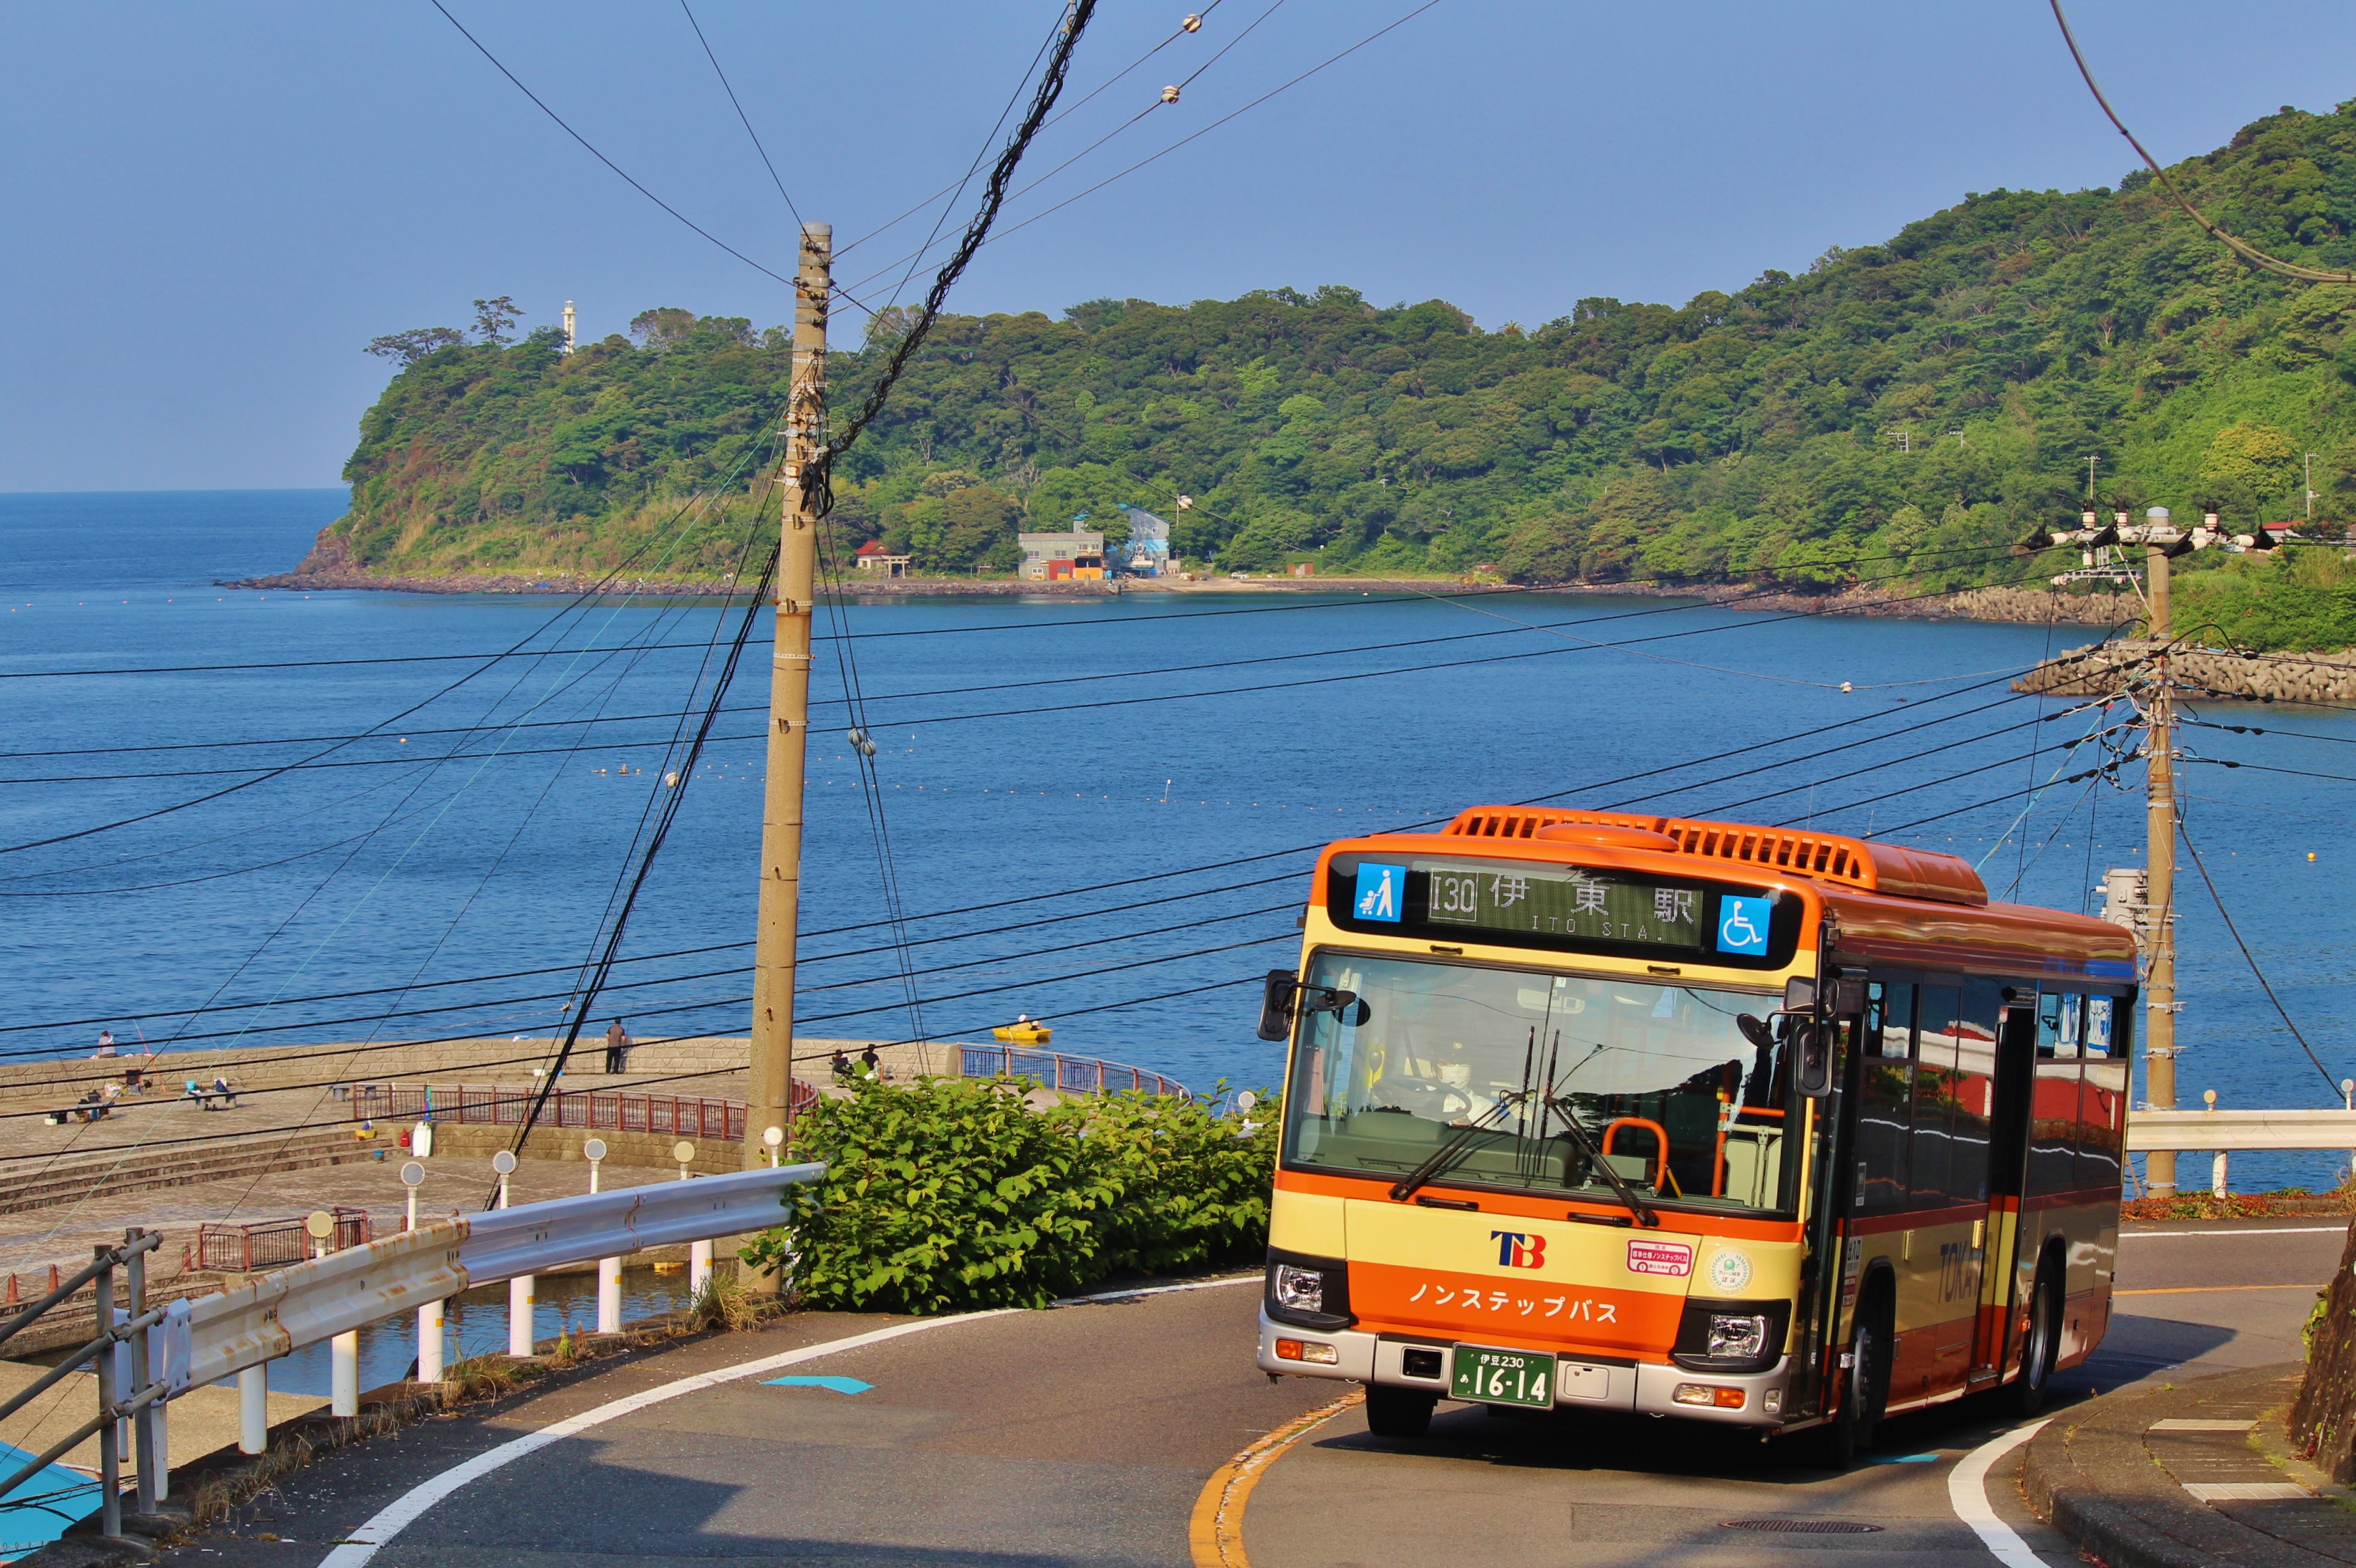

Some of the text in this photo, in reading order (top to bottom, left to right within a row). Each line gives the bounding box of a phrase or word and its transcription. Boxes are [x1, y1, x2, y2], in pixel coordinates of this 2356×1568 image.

[1532, 915, 1663, 941] ITO STA.
[1490, 1230, 1547, 1269] TB
[1410, 1284, 1617, 1324] ノンステップバス
[1460, 1365, 1546, 1402] あ 16-14
